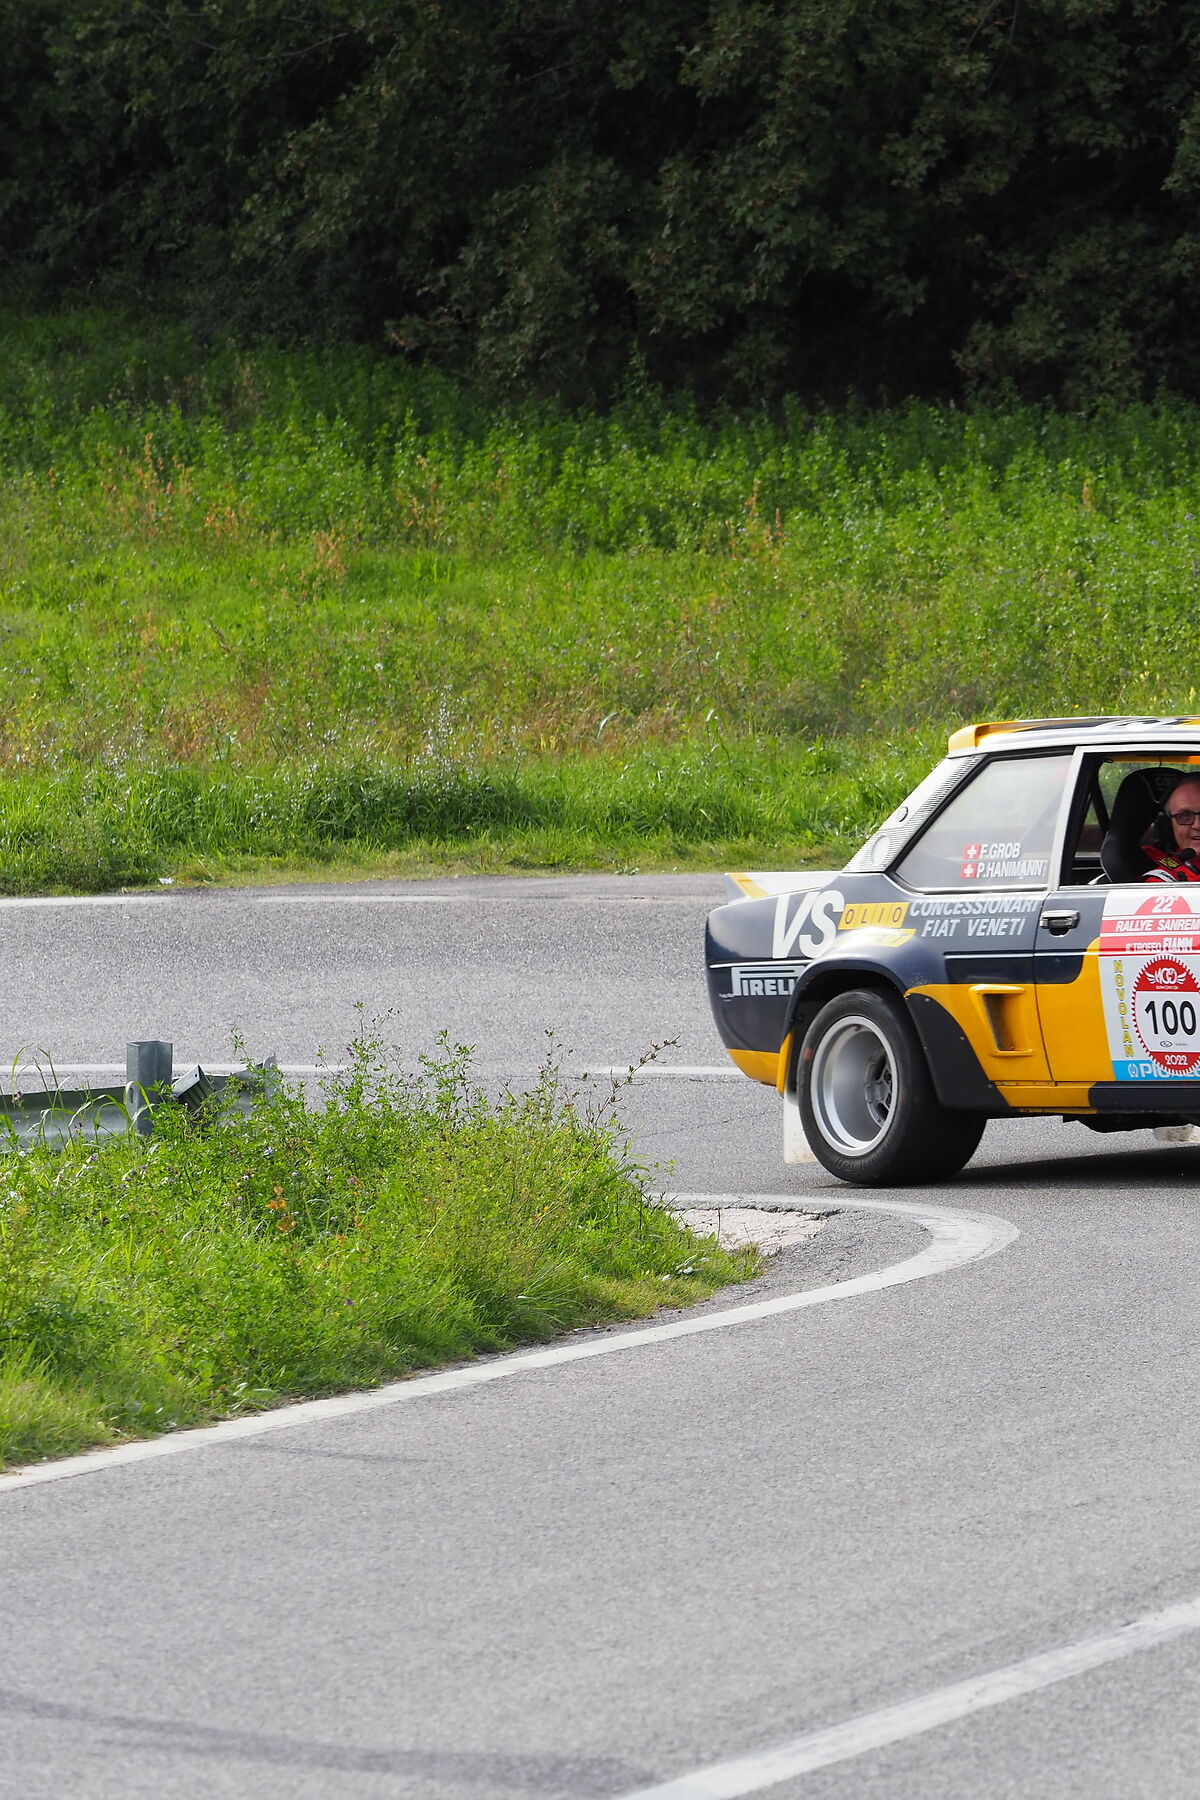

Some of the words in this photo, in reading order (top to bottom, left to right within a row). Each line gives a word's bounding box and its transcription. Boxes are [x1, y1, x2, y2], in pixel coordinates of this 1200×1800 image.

[772, 890, 845, 959] VS
[845, 907, 902, 925] OLIO
[1115, 919, 1153, 932] RALLYE
[921, 919, 960, 938] FIAT
[967, 918, 1027, 937] VENETI
[1144, 1000, 1197, 1036] 100
[1164, 1054, 1189, 1066] 2022
